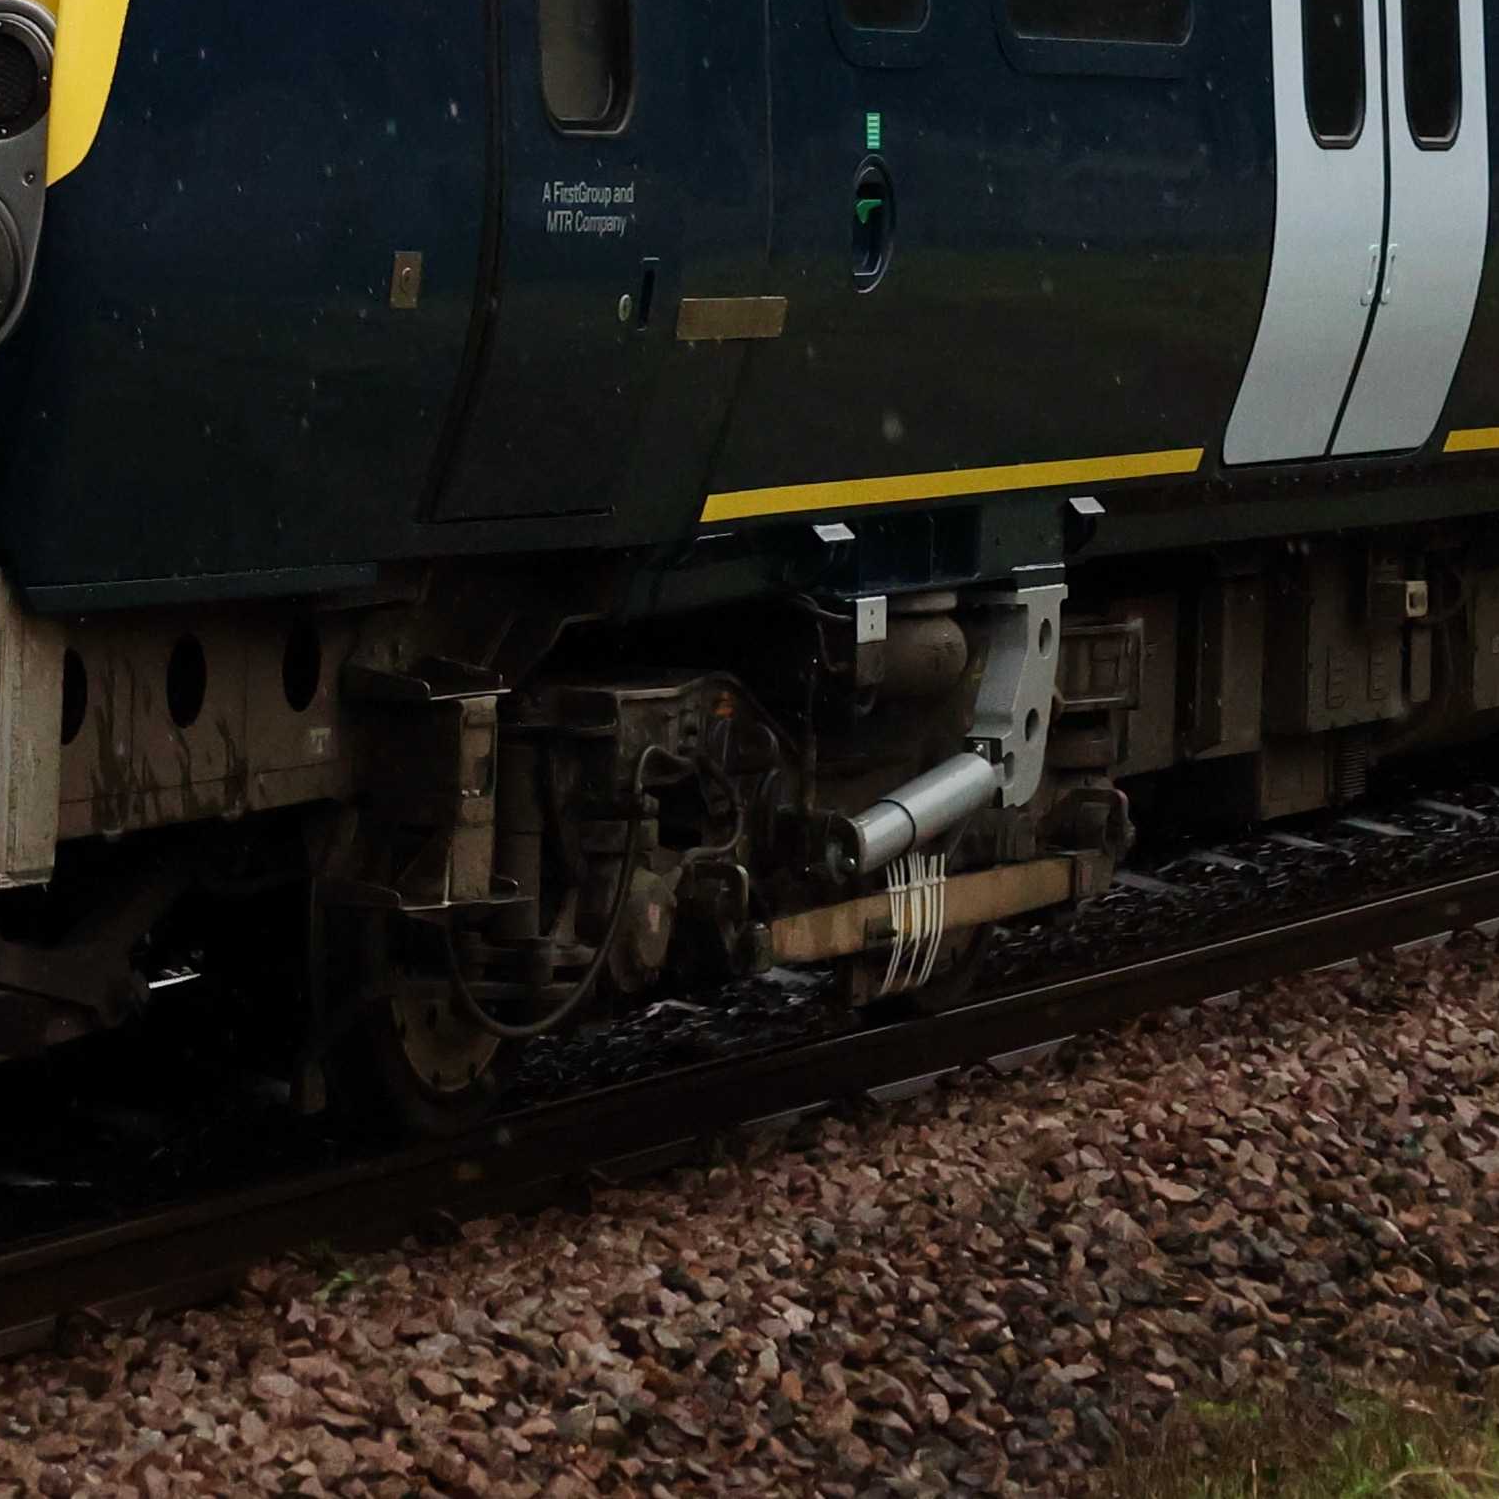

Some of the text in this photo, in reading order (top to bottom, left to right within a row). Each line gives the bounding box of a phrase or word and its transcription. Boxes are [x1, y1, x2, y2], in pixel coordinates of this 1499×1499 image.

[542, 180, 635, 209] A FirstGroup and
[546, 209, 627, 238] MTR Company
